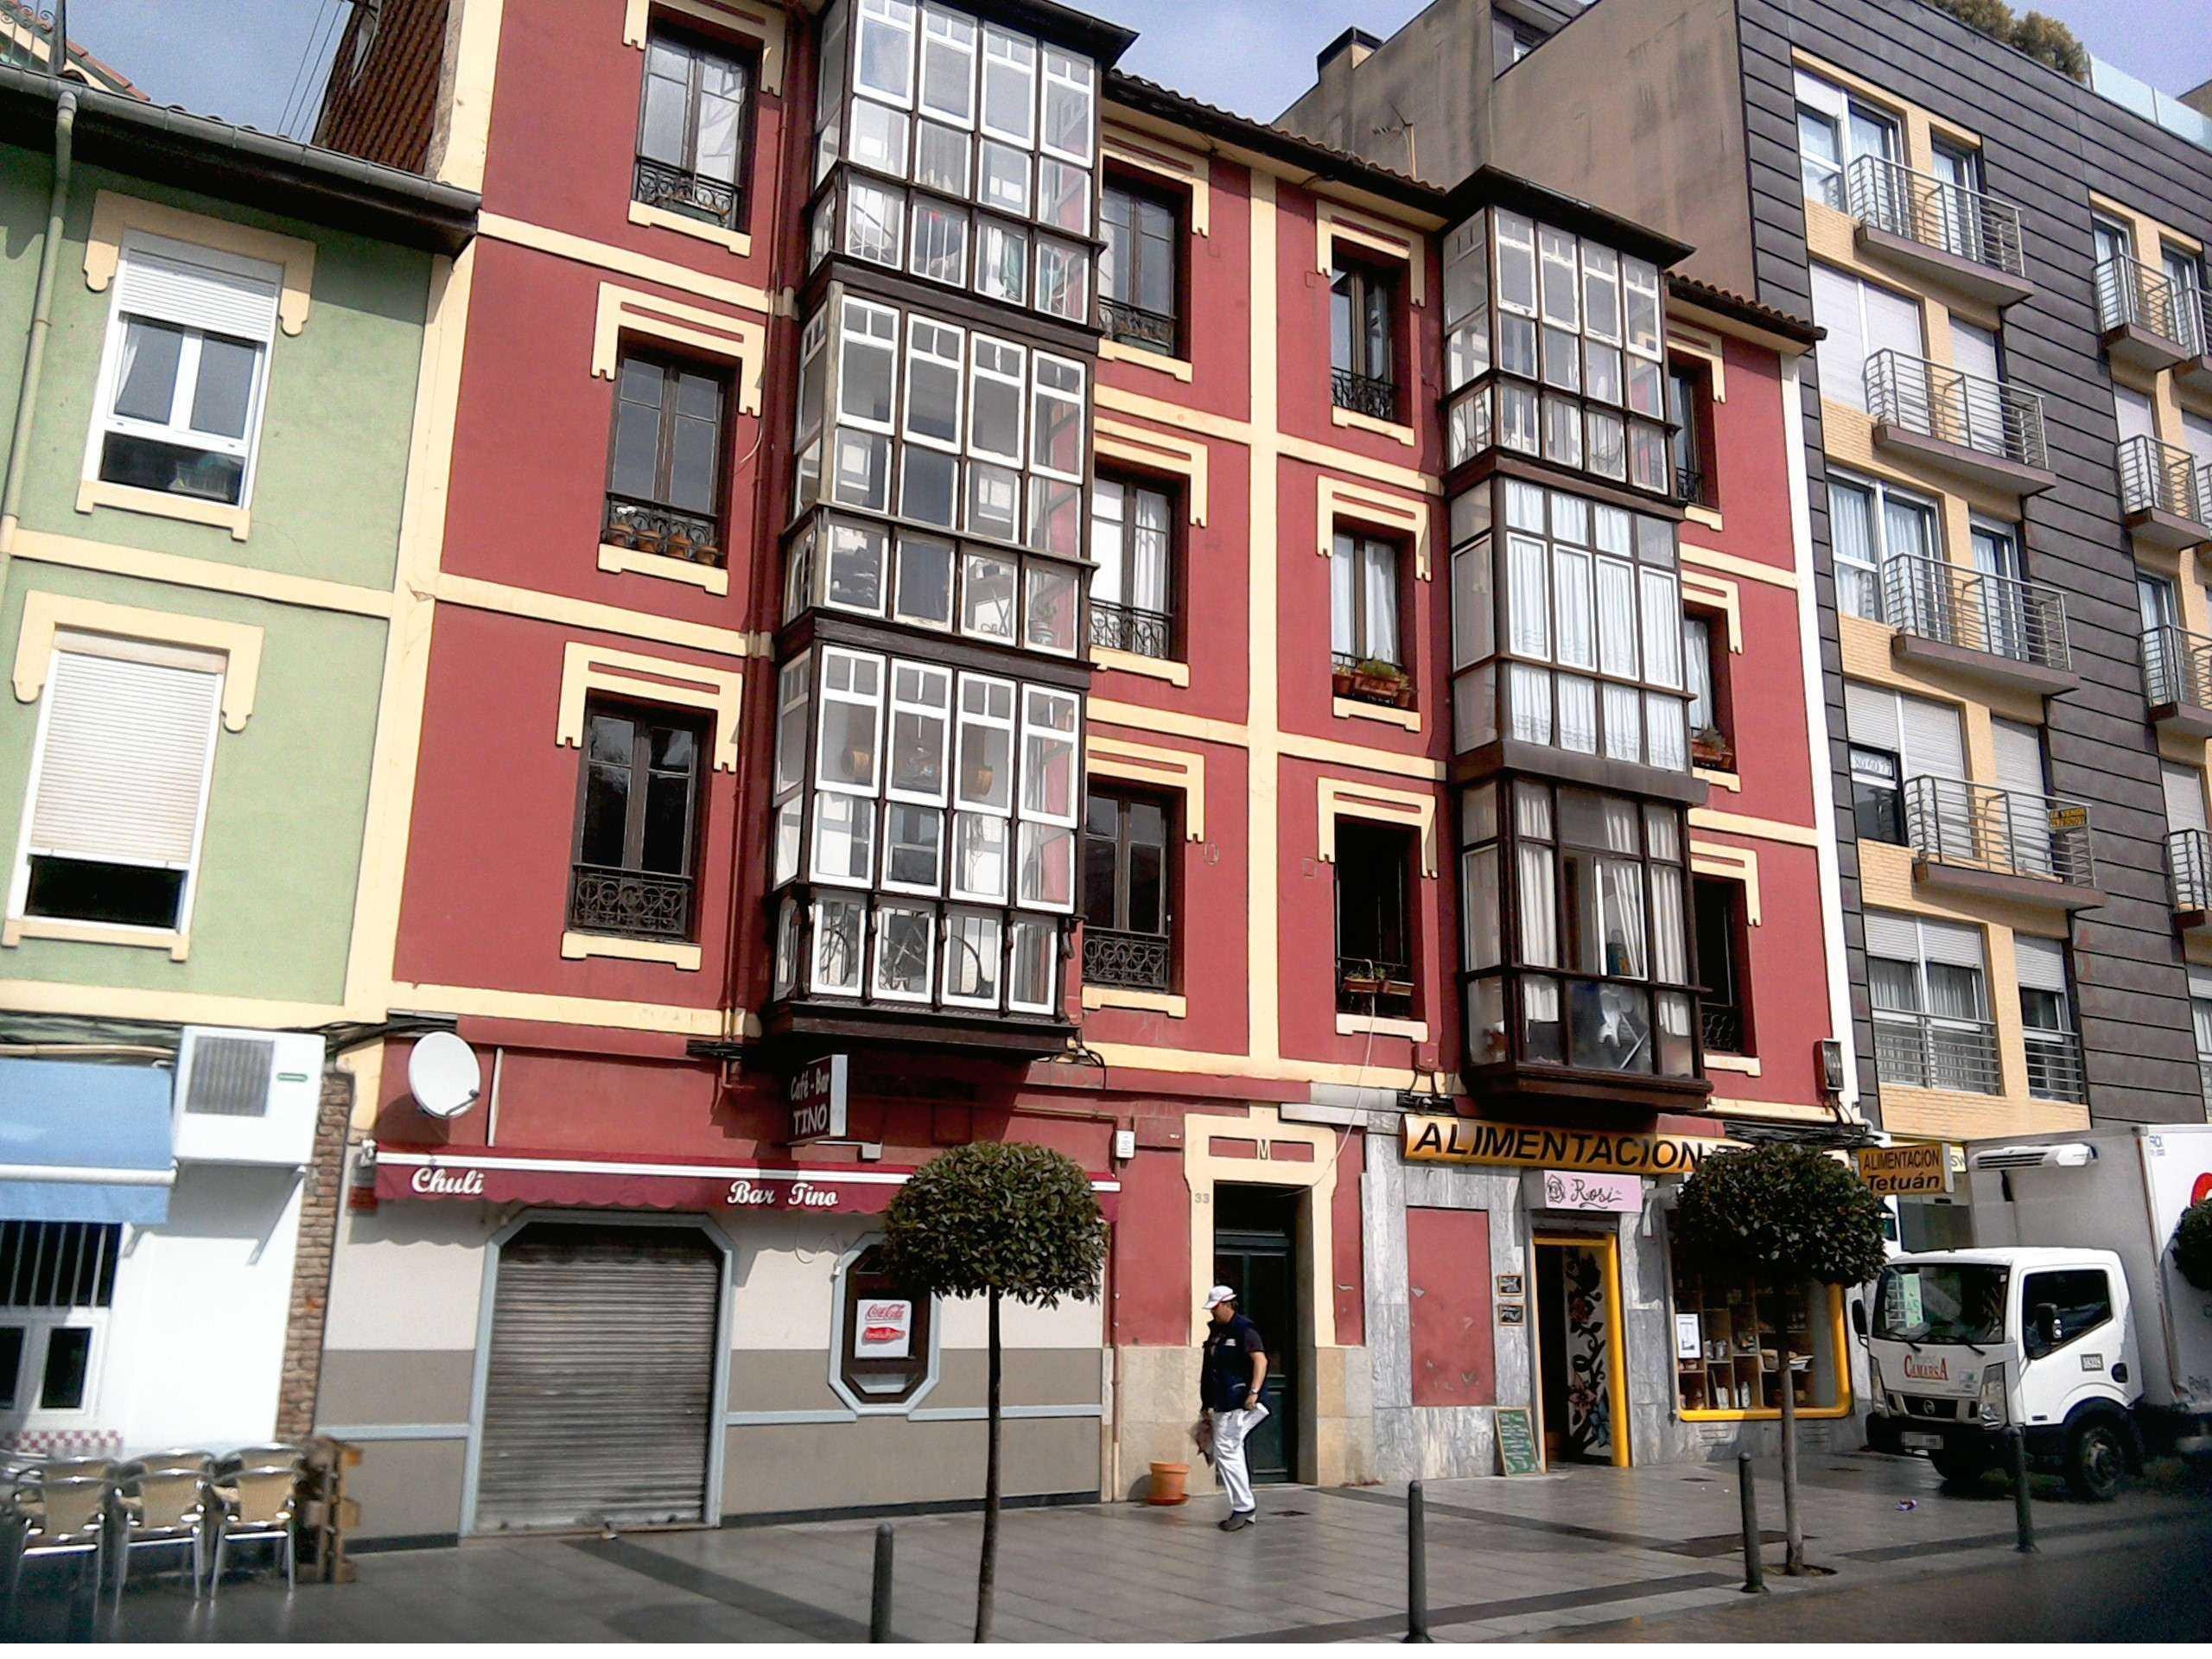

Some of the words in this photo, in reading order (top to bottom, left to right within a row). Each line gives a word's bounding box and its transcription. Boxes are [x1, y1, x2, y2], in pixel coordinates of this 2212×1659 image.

[793, 1103, 827, 1135] TINO
[1413, 1122, 1702, 1170] ALIMENTACION
[411, 1167, 485, 1194] Chuli
[727, 1180, 776, 1204] Bar
[788, 1182, 838, 1206] Tino
[1866, 1171, 1940, 1192] Tetuán
[1194, 1192, 1210, 1204] 33
